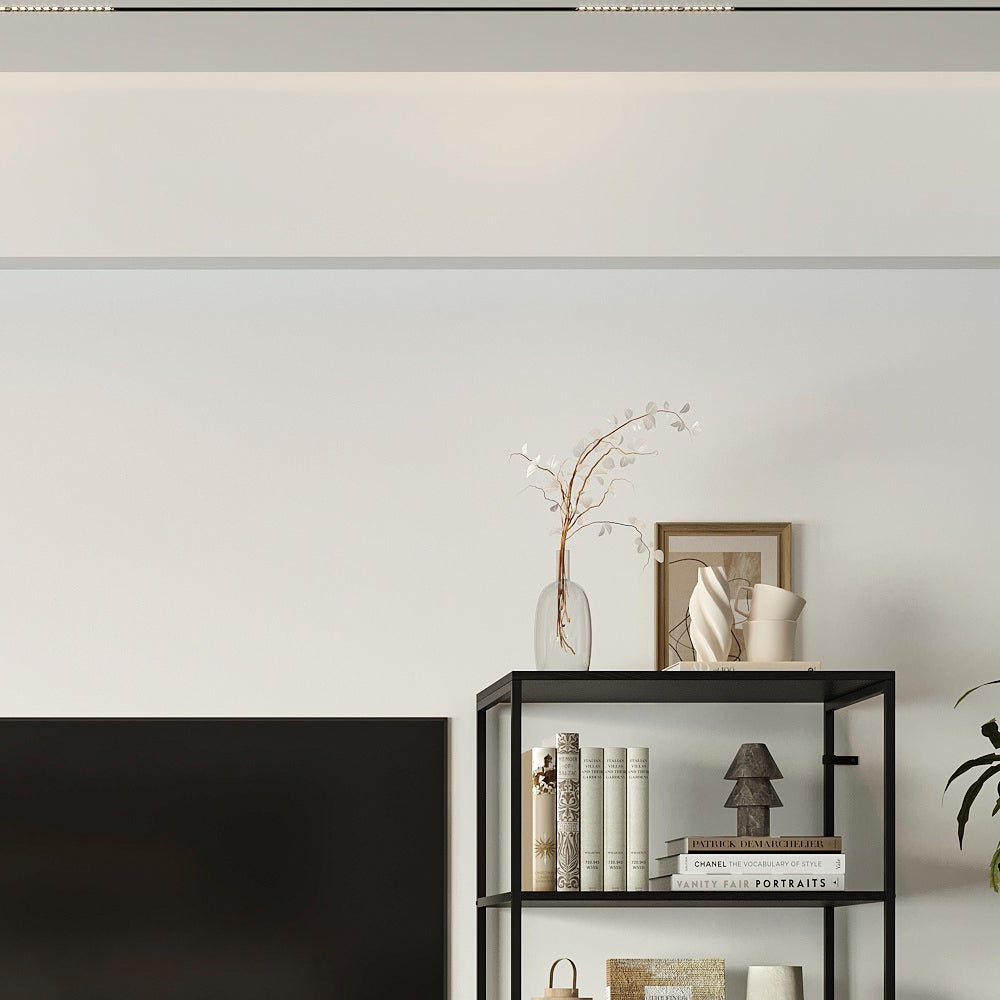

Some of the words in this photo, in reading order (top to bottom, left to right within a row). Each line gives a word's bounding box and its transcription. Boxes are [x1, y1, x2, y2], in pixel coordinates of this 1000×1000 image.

[692, 840, 736, 848] PATRICK
[677, 880, 717, 888] VANITY
[723, 880, 750, 888] FAIR
[755, 879, 826, 888] PORTRAITS
